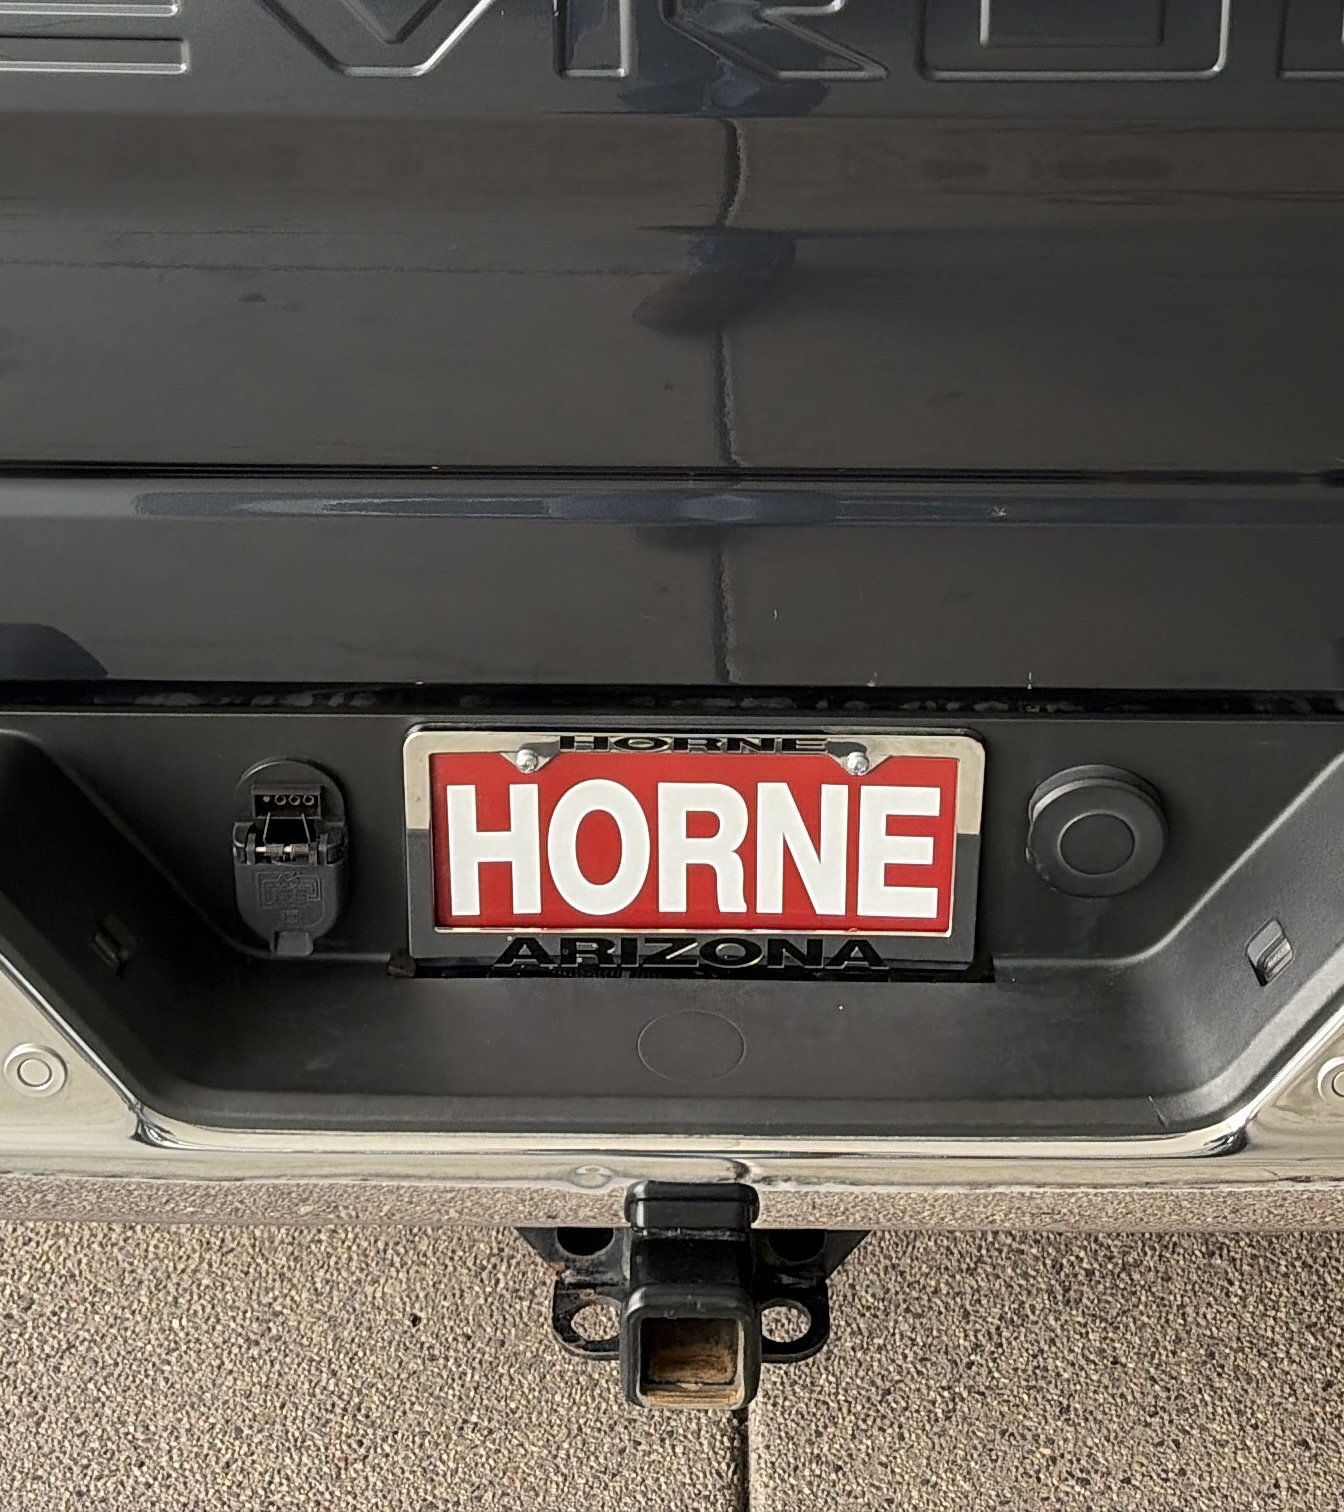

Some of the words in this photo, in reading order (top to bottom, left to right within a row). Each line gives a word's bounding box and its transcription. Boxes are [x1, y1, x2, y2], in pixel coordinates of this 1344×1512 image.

[558, 735, 828, 753] HORNE
[446, 778, 942, 918] HORNE
[493, 936, 890, 970] ARIZONA
